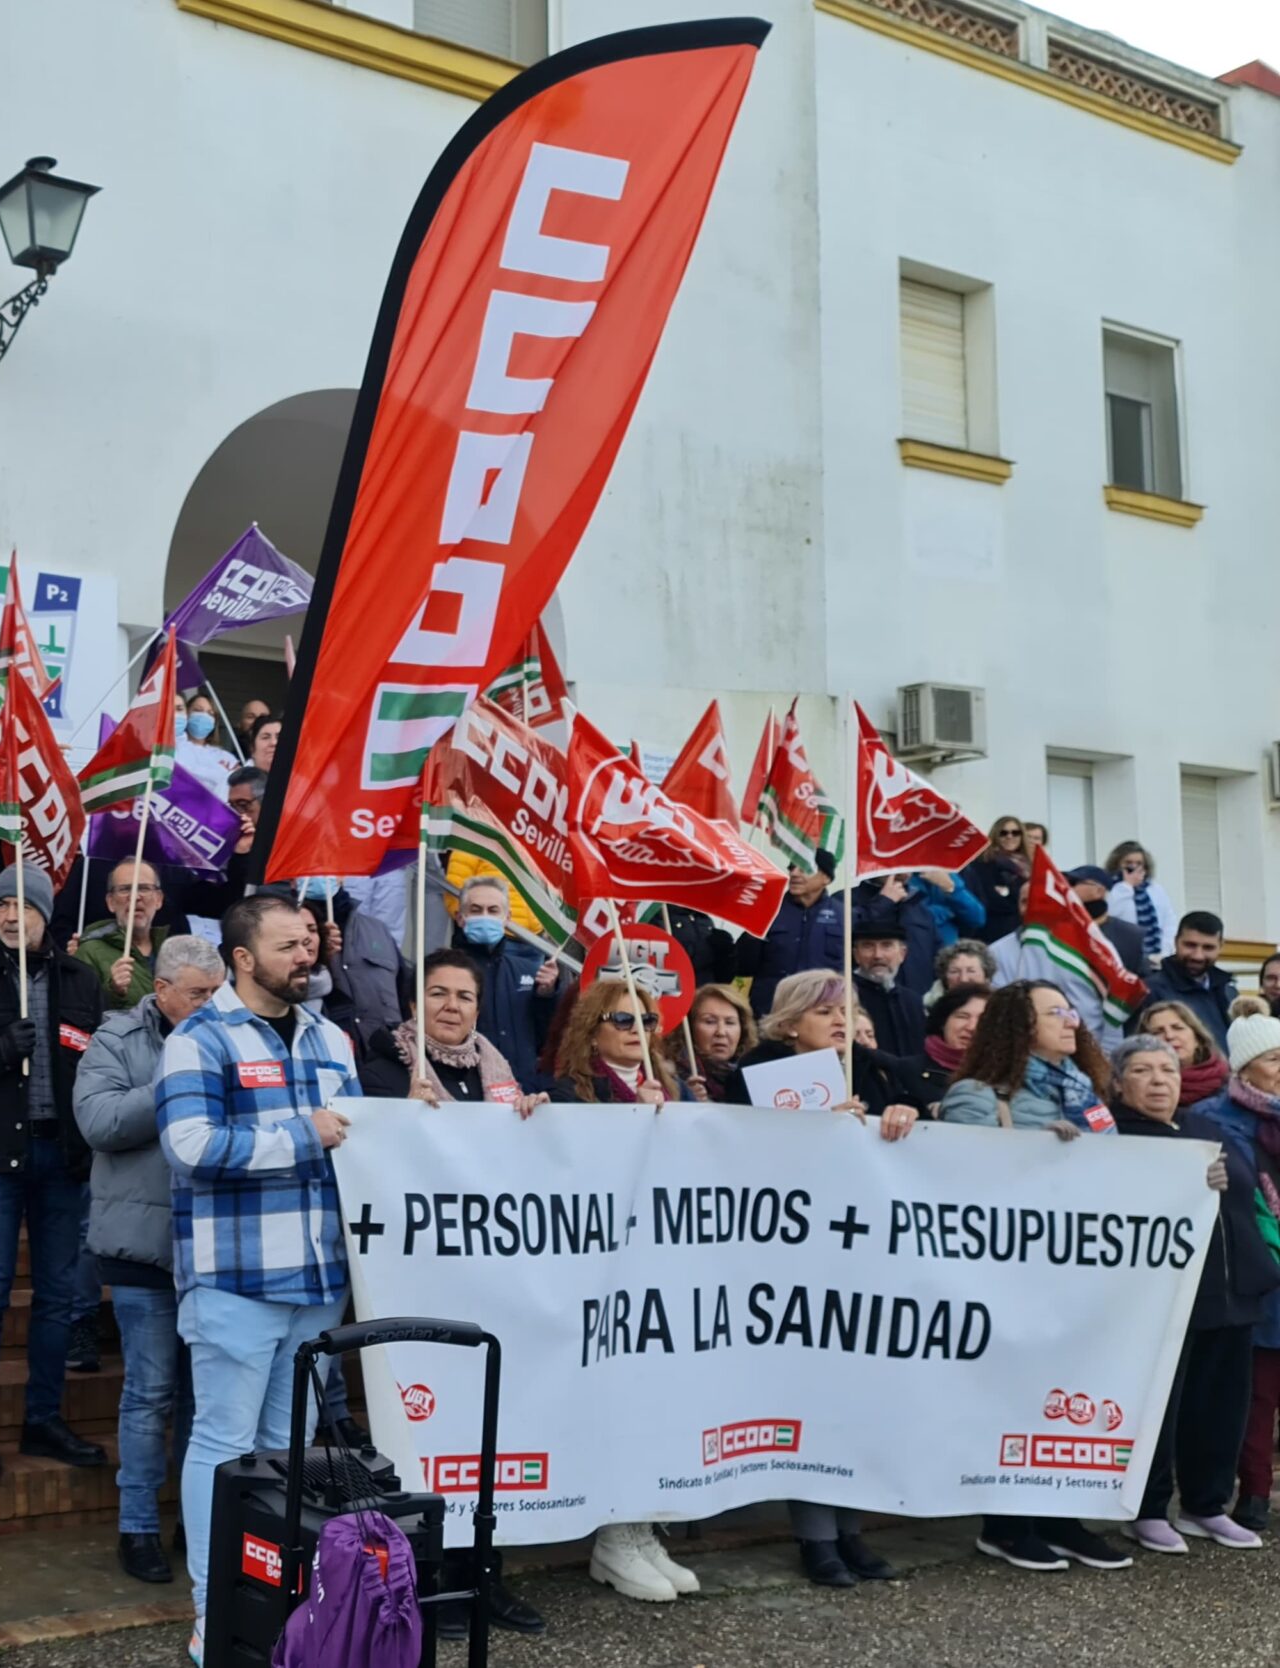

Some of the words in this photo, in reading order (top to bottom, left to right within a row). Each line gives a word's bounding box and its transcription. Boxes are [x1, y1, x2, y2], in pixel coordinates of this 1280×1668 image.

[388, 141, 630, 667] CCOO
[46, 583, 68, 602] P2
[510, 808, 573, 874] Sevilla
[607, 937, 670, 970] UGT
[349, 1203, 385, 1255] +
[403, 1193, 619, 1257] PERSONAL
[652, 1186, 812, 1246] MEDIOS
[829, 1205, 870, 1251] +
[888, 1199, 1195, 1270] PRESUPUESTOS
[364, 1325, 433, 1345] Caperlan
[581, 1288, 676, 1368] PARA
[694, 1285, 733, 1353] LA
[746, 1282, 992, 1361] SANIDAD
[722, 1425, 775, 1454] CCOO
[1036, 1440, 1112, 1465] CCOO
[438, 1460, 521, 1487] CCO
[658, 1477, 703, 1490] Sindicato
[770, 1459, 854, 1478] Sociosanitarios
[999, 1474, 1010, 1484] de
[1014, 1473, 1053, 1486] Sanidad
[1055, 1478, 1062, 1490] y
[1066, 1477, 1108, 1489] Sectores
